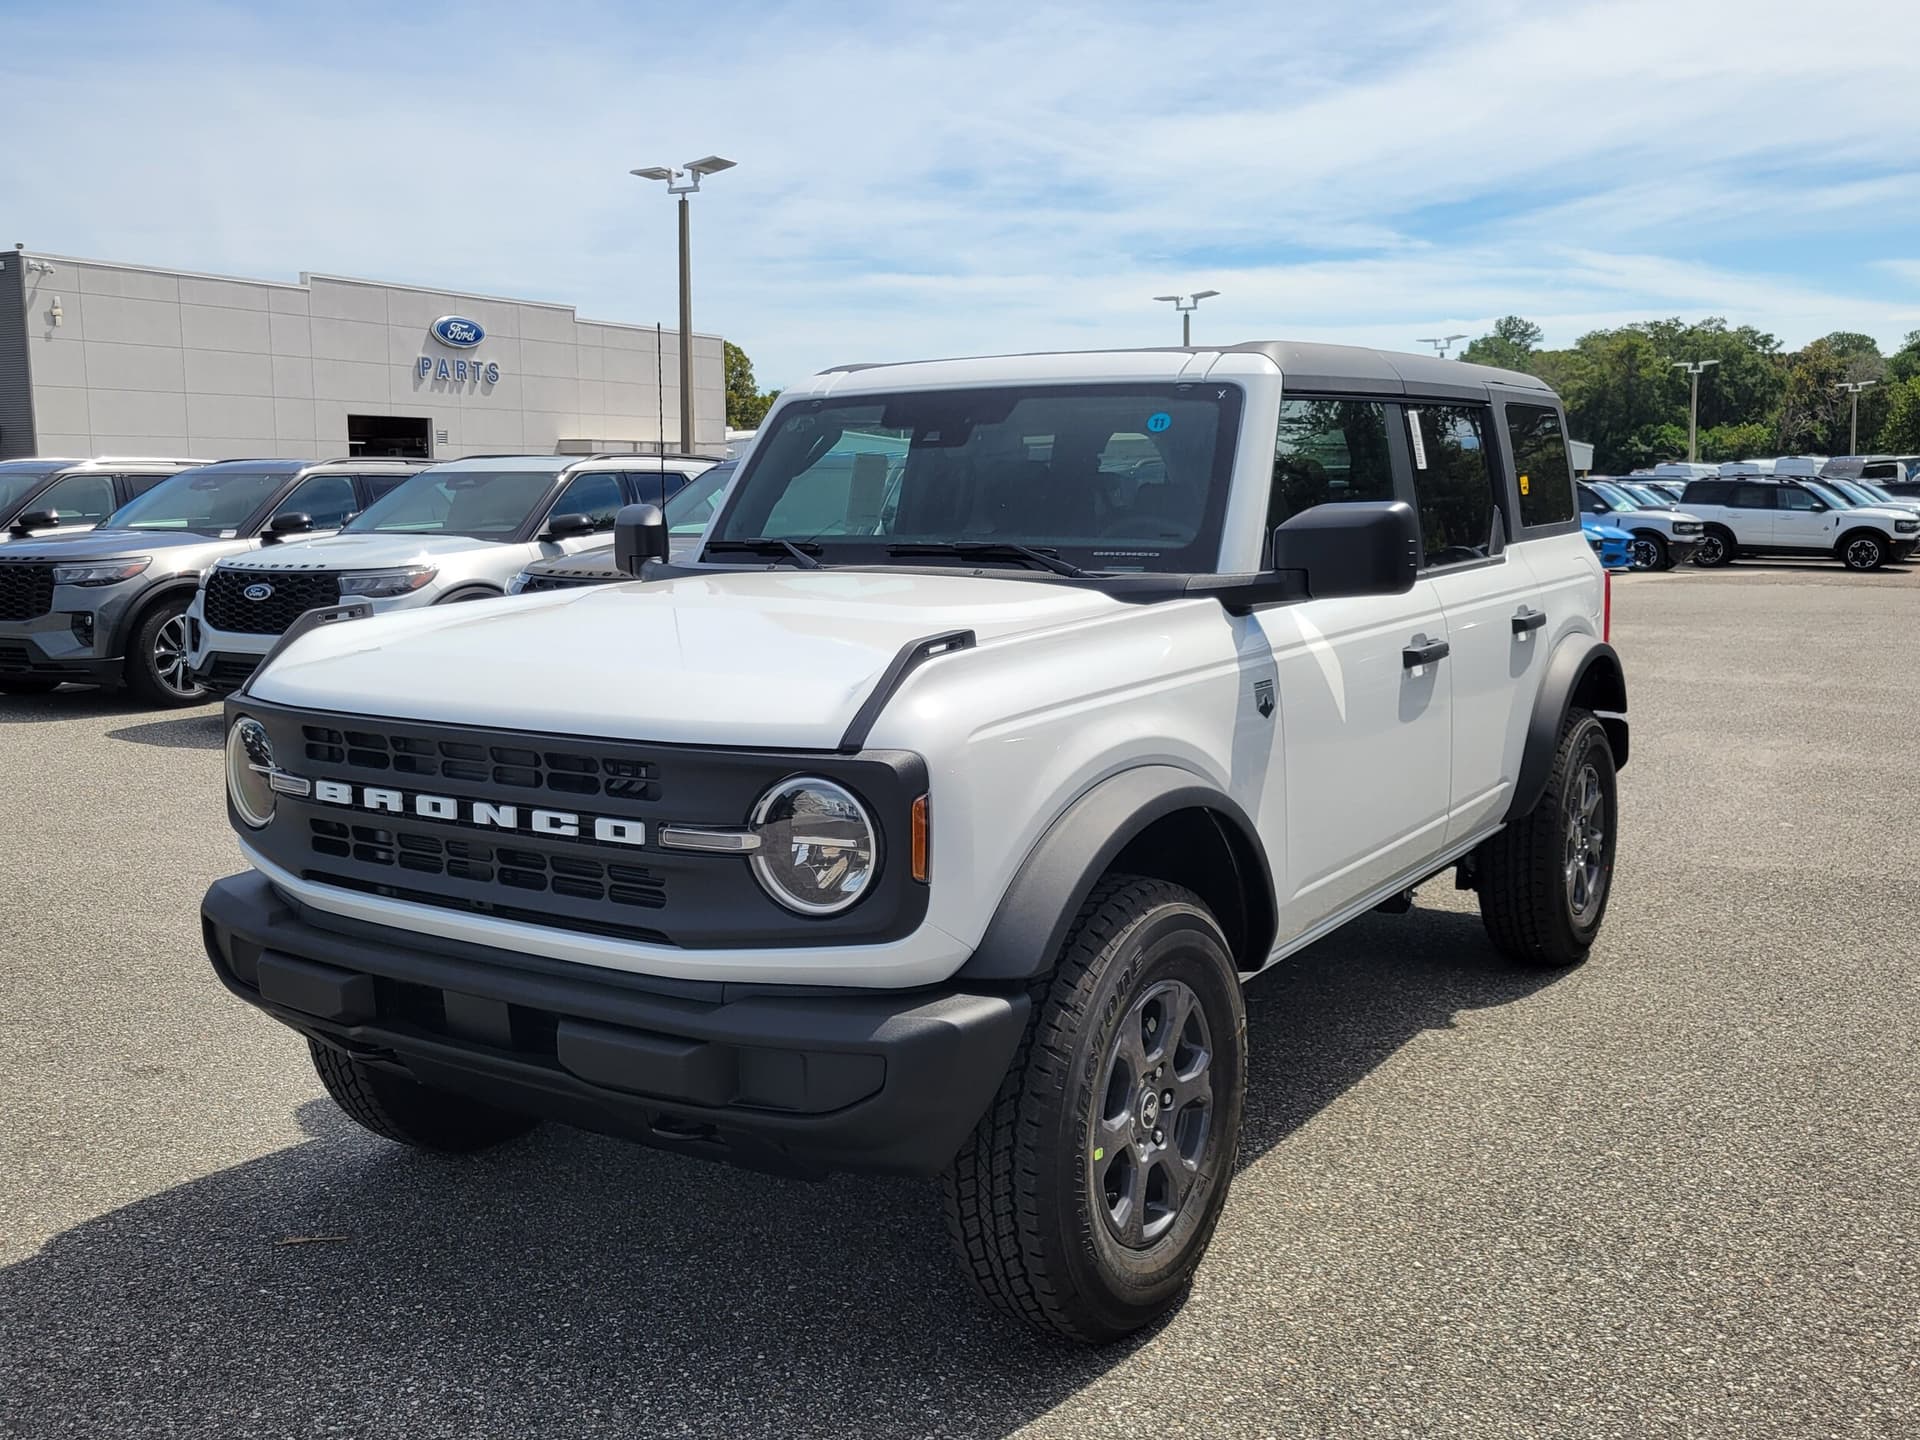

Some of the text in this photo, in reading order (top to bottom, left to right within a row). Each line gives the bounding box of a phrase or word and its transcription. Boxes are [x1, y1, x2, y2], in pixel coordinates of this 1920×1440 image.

[447, 322, 476, 341] Ford
[417, 356, 500, 384] PARTS
[315, 780, 646, 846] BRONCO
